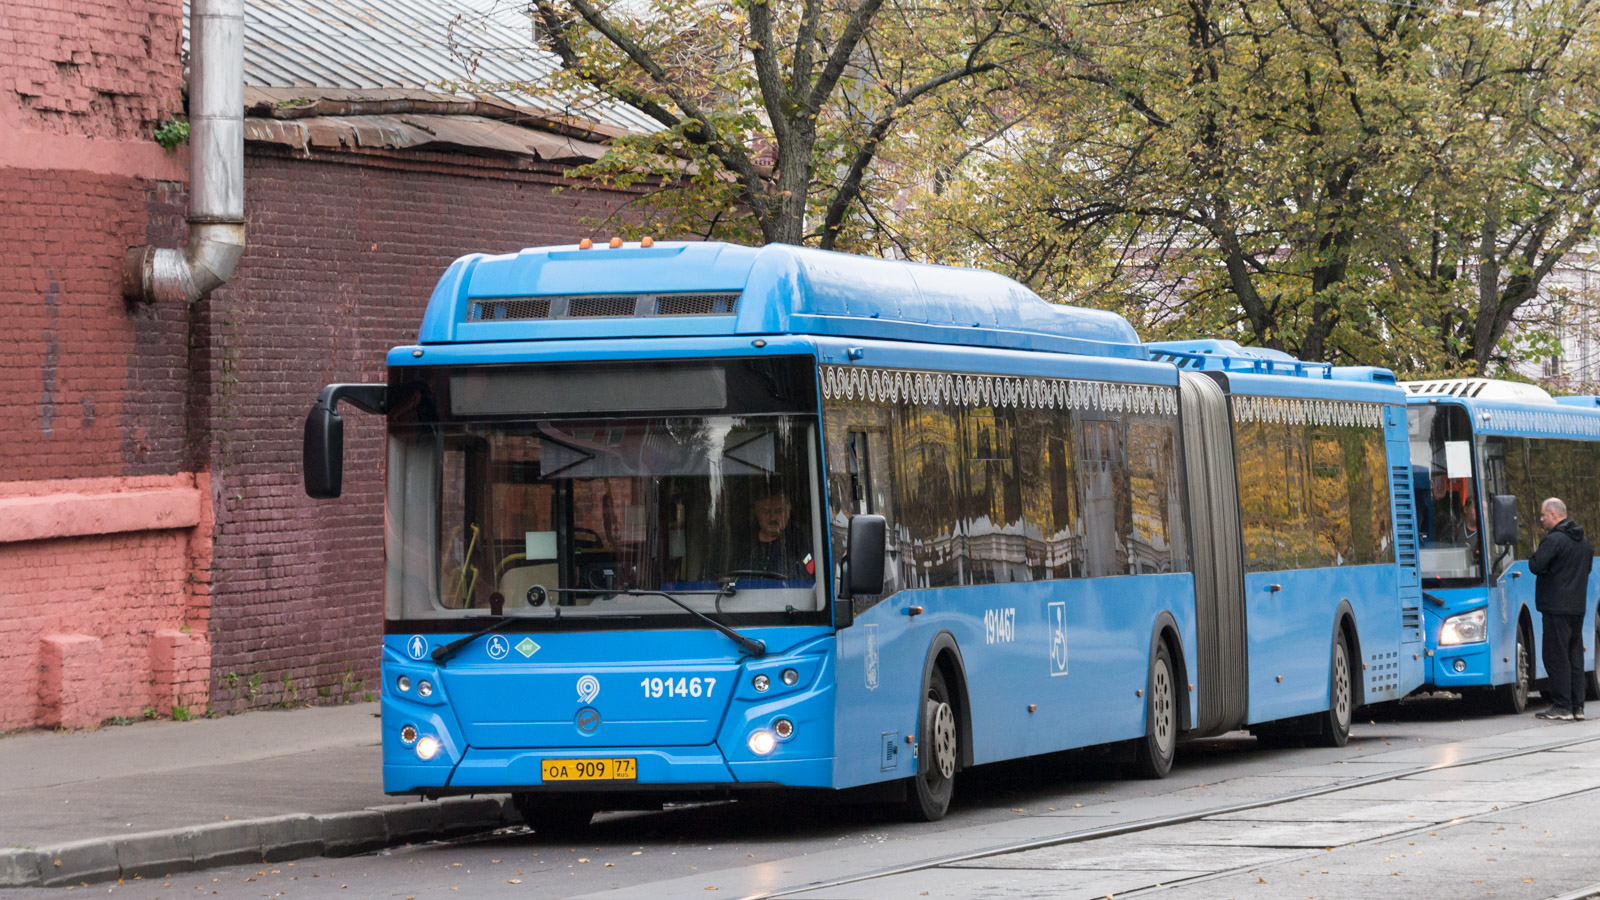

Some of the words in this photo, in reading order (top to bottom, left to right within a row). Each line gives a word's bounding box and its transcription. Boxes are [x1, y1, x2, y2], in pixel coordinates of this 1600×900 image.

[984, 607, 1016, 645] 191467
[640, 676, 717, 699] 191467
[575, 761, 605, 778] 909
[614, 760, 630, 773] 77
